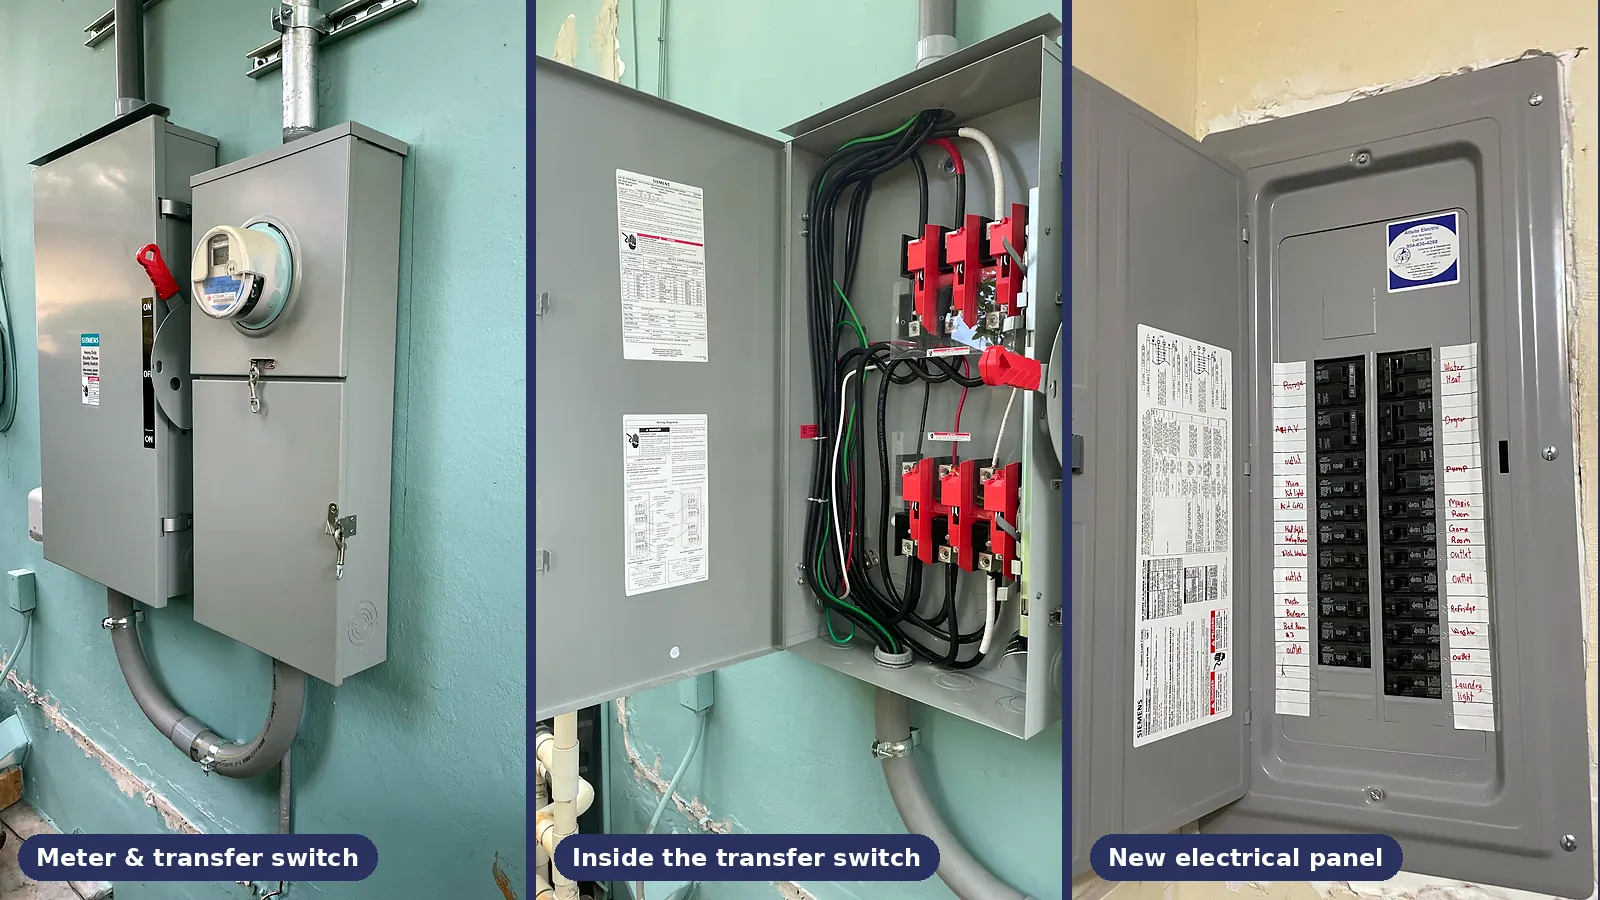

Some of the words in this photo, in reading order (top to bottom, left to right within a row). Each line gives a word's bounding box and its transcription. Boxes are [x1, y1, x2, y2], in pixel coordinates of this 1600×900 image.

[143, 303, 152, 311] ON
[81, 336, 99, 344] SIEMENS
[1444, 361, 1464, 371] Water
[1446, 372, 1461, 384] Heat
[144, 435, 153, 443] ON
[1449, 524, 1469, 533] Game
[1451, 536, 1471, 544] Room
[1455, 678, 1482, 693] Laundry
